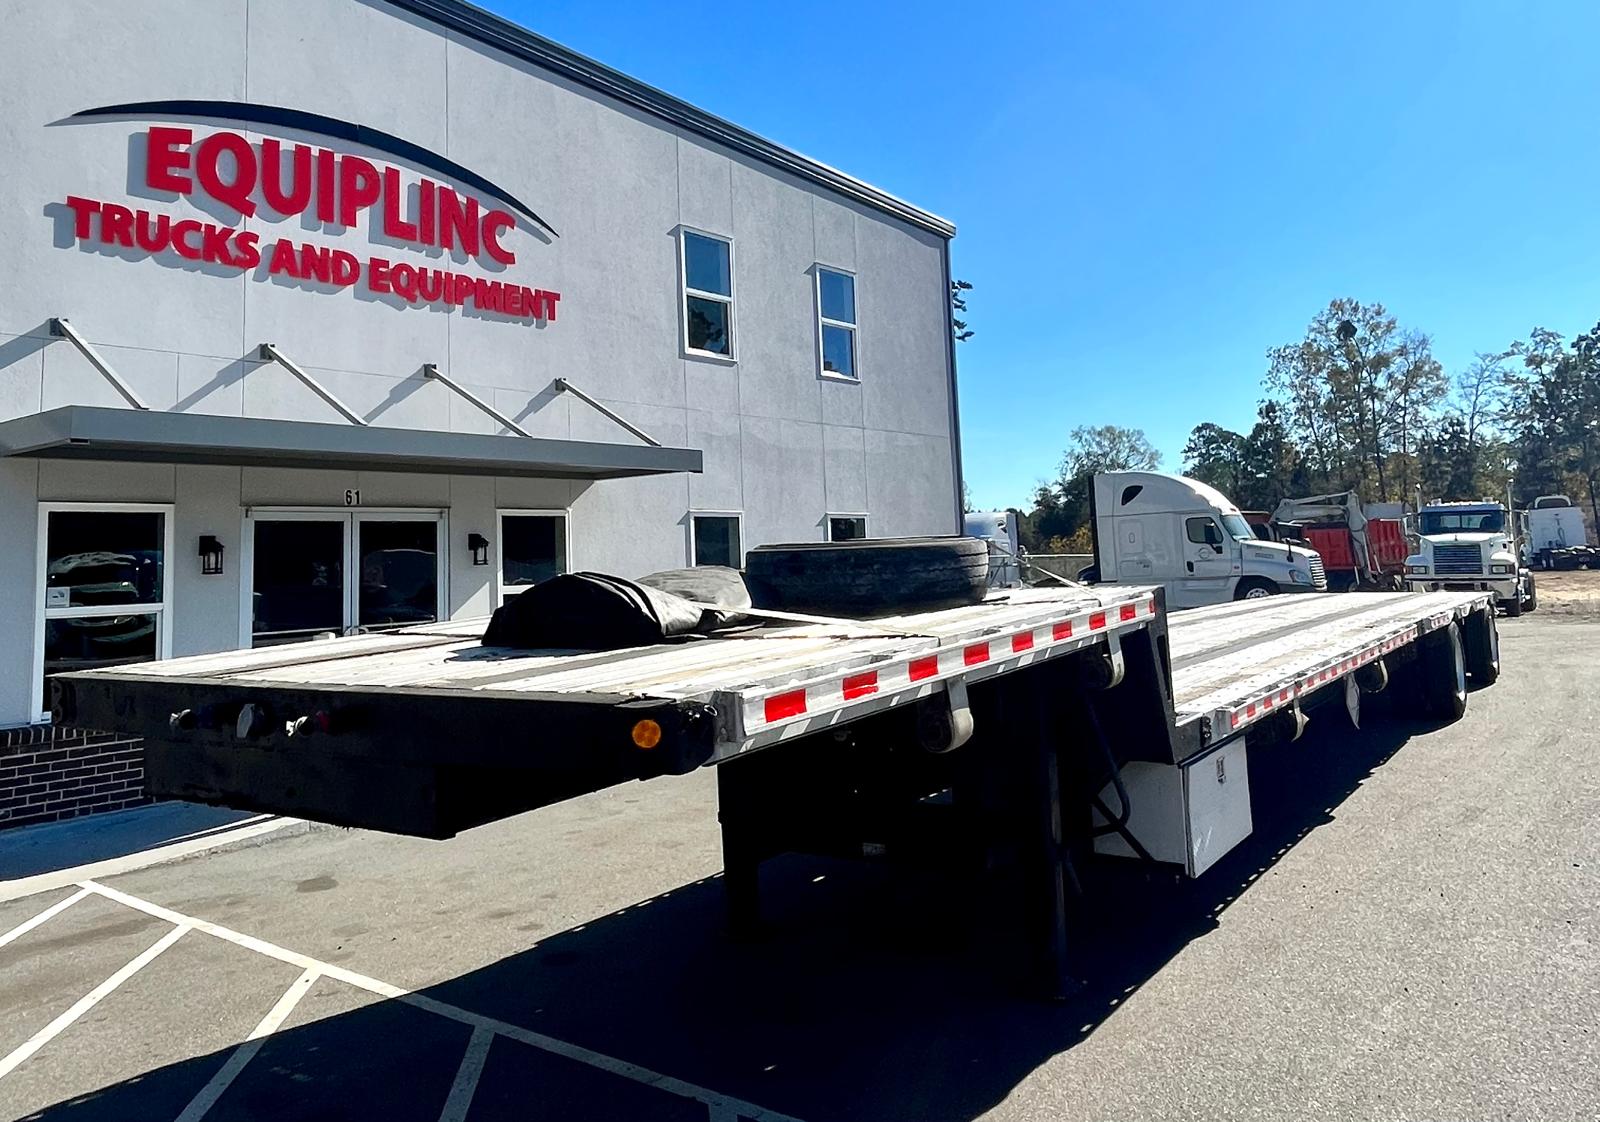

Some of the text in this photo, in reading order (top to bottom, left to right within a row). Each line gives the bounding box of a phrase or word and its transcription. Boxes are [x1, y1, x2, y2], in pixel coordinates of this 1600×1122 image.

[146, 126, 517, 265] EQUIPLINC
[66, 196, 561, 321] TRUCKS AND EQUIPMENT
[345, 489, 360, 505] 61
